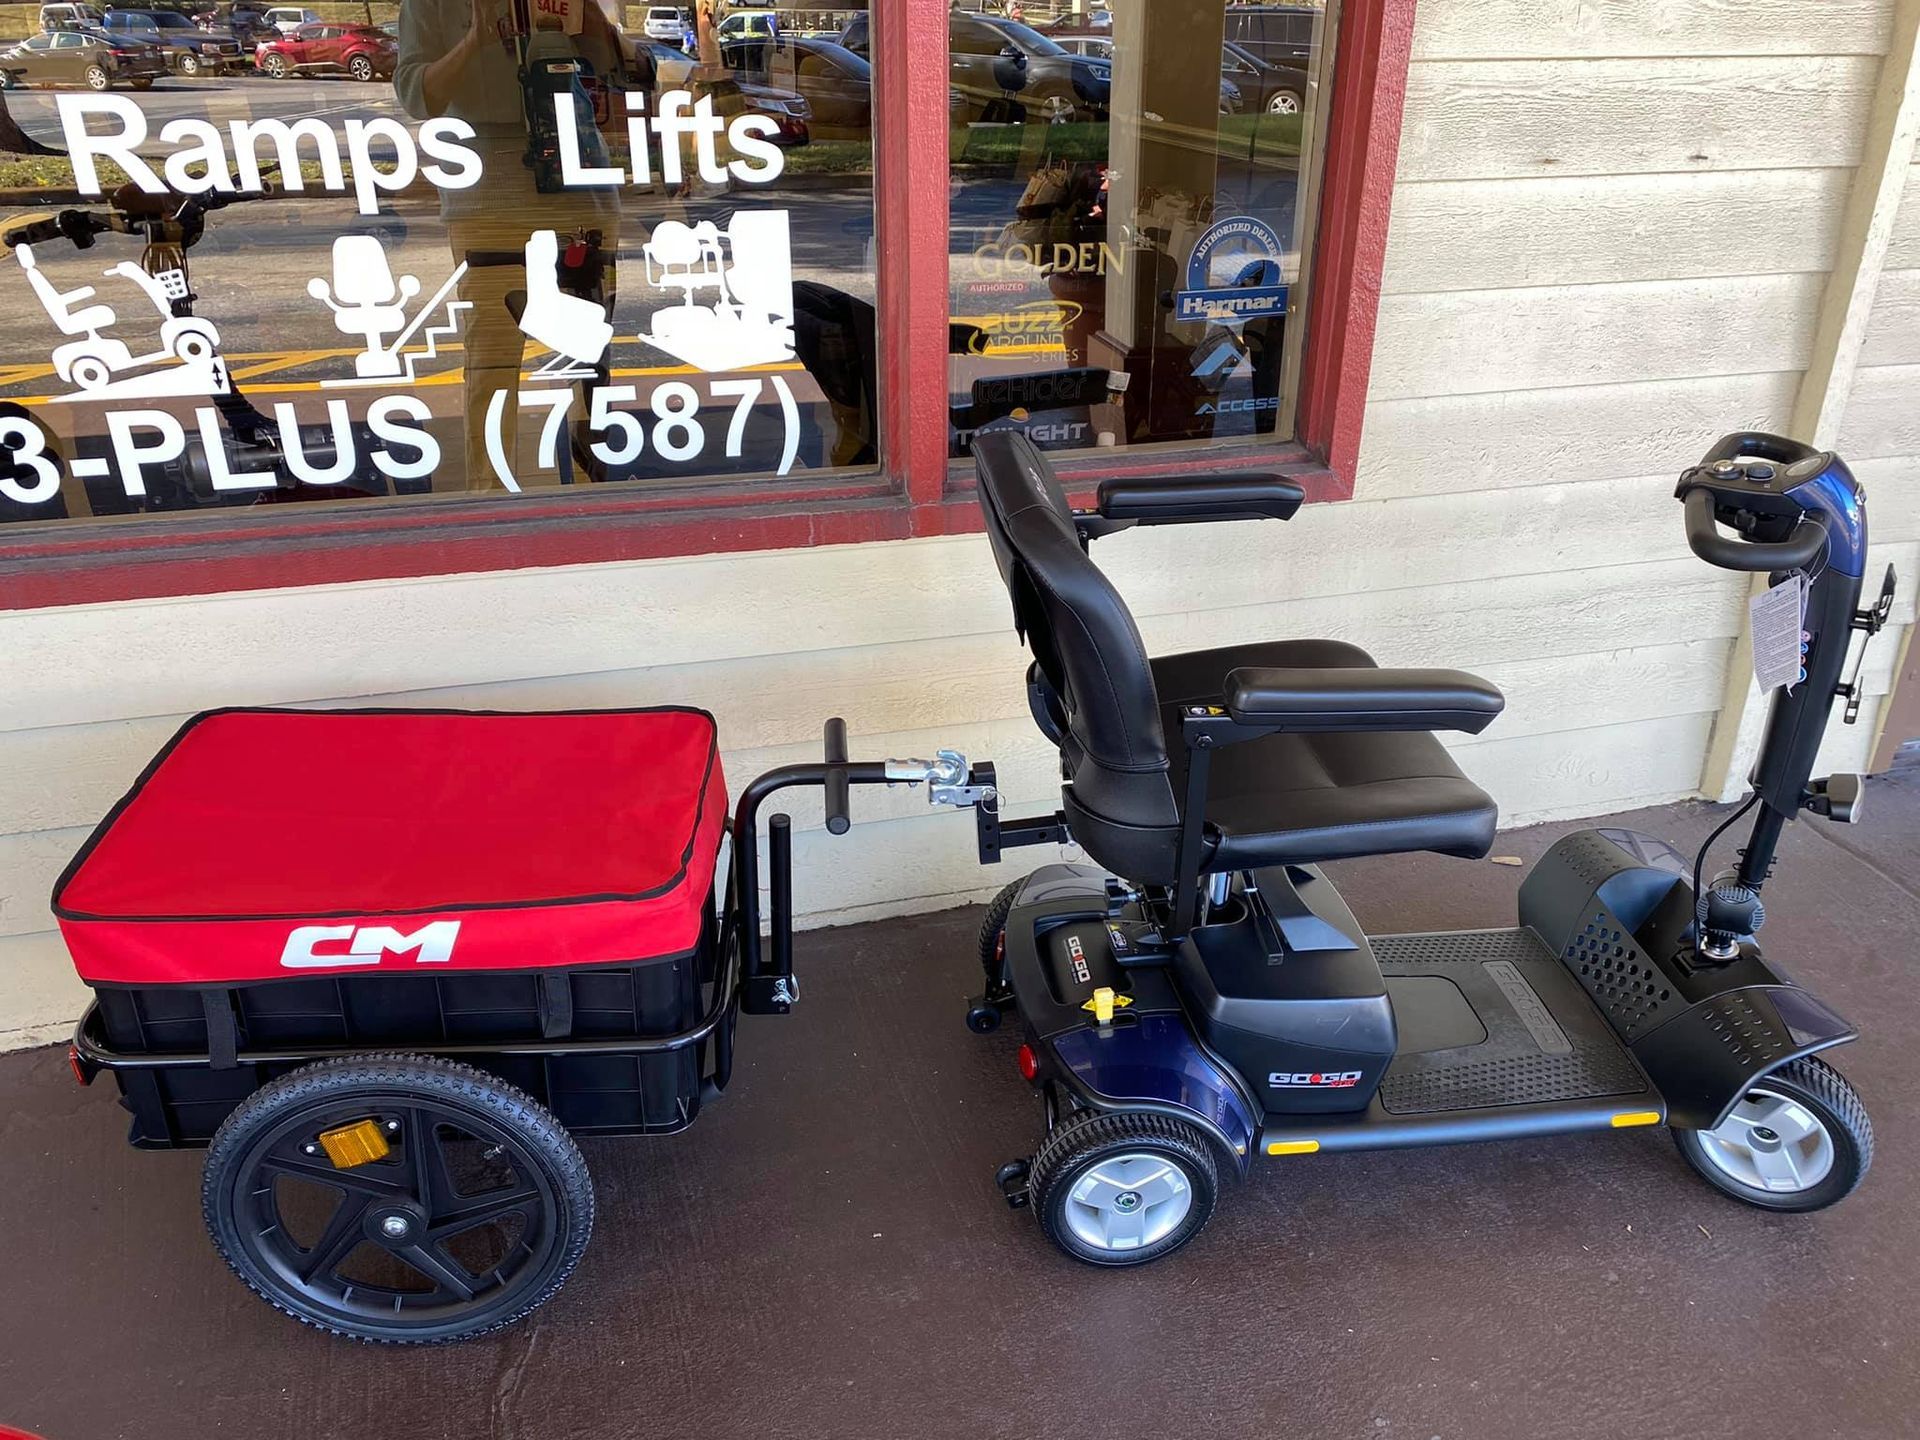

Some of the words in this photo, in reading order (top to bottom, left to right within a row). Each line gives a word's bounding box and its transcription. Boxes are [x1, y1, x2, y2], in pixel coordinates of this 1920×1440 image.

[537, 0, 569, 16] SALE
[55, 92, 483, 215] Ramps
[553, 89, 785, 187] Lifts
[1196, 222, 1251, 260] AUTHORIZED
[1251, 225, 1278, 258] DEALER
[972, 241, 1130, 278] GOLDEN
[969, 282, 1025, 293] AUTHORIZED
[1182, 296, 1279, 314] Harmar
[1033, 348, 1079, 364] SERIES
[1194, 396, 1280, 416] ACCESS
[0, 395, 441, 504] 3-PLUS
[484, 375, 801, 493] (7587)
[280, 920, 462, 968] CM
